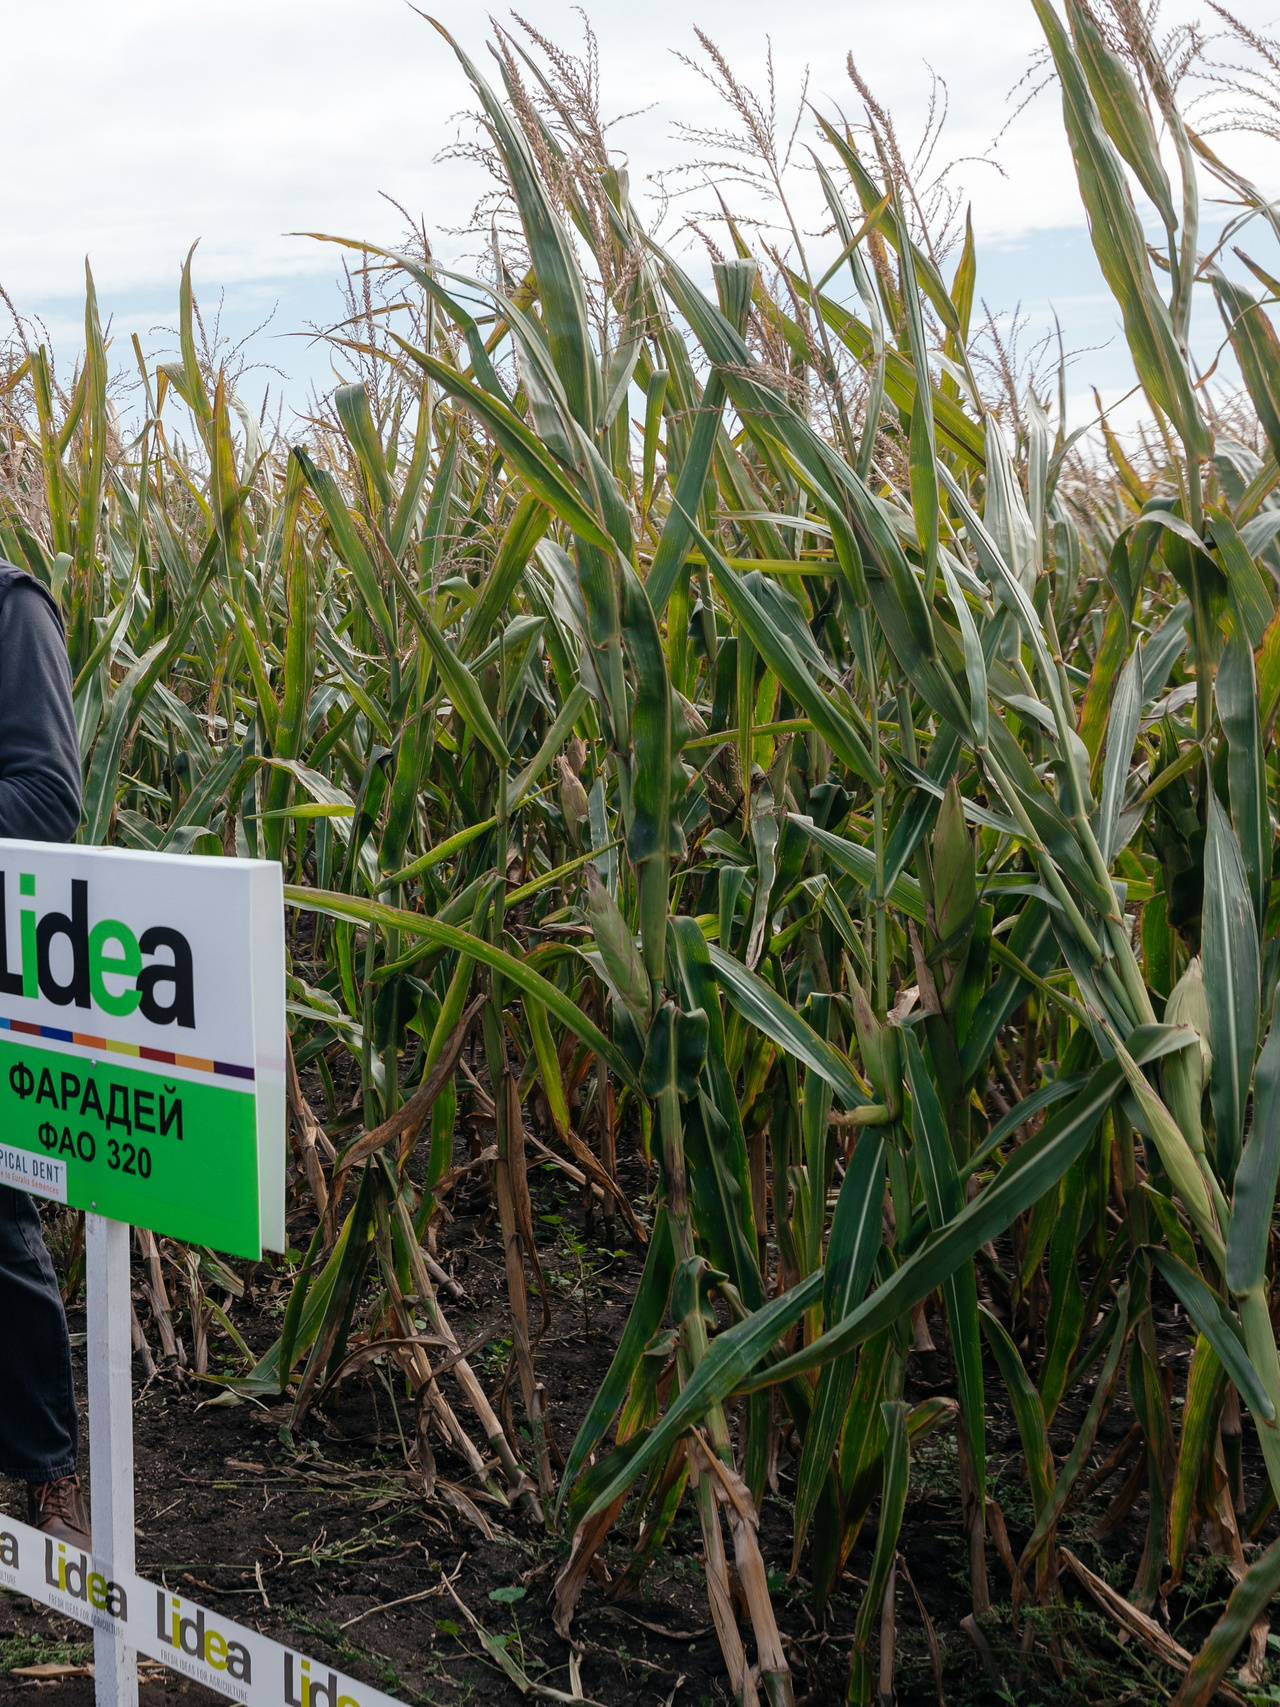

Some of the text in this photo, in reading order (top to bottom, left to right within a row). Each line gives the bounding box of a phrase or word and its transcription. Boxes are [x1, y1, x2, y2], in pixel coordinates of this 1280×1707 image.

[8, 1061, 184, 1140] ФАРАДЕЙ
[37, 1121, 152, 1179] ФАО 320
[5, 1171, 11, 1179] to
[31, 1179, 59, 1195] Semences
[44, 1537, 128, 1623] Lidea
[156, 1589, 252, 1685] Lidea
[284, 1651, 361, 1707] Lid
[160, 1649, 248, 1702] FRESH IDEAS FOR AGRICULTURE
